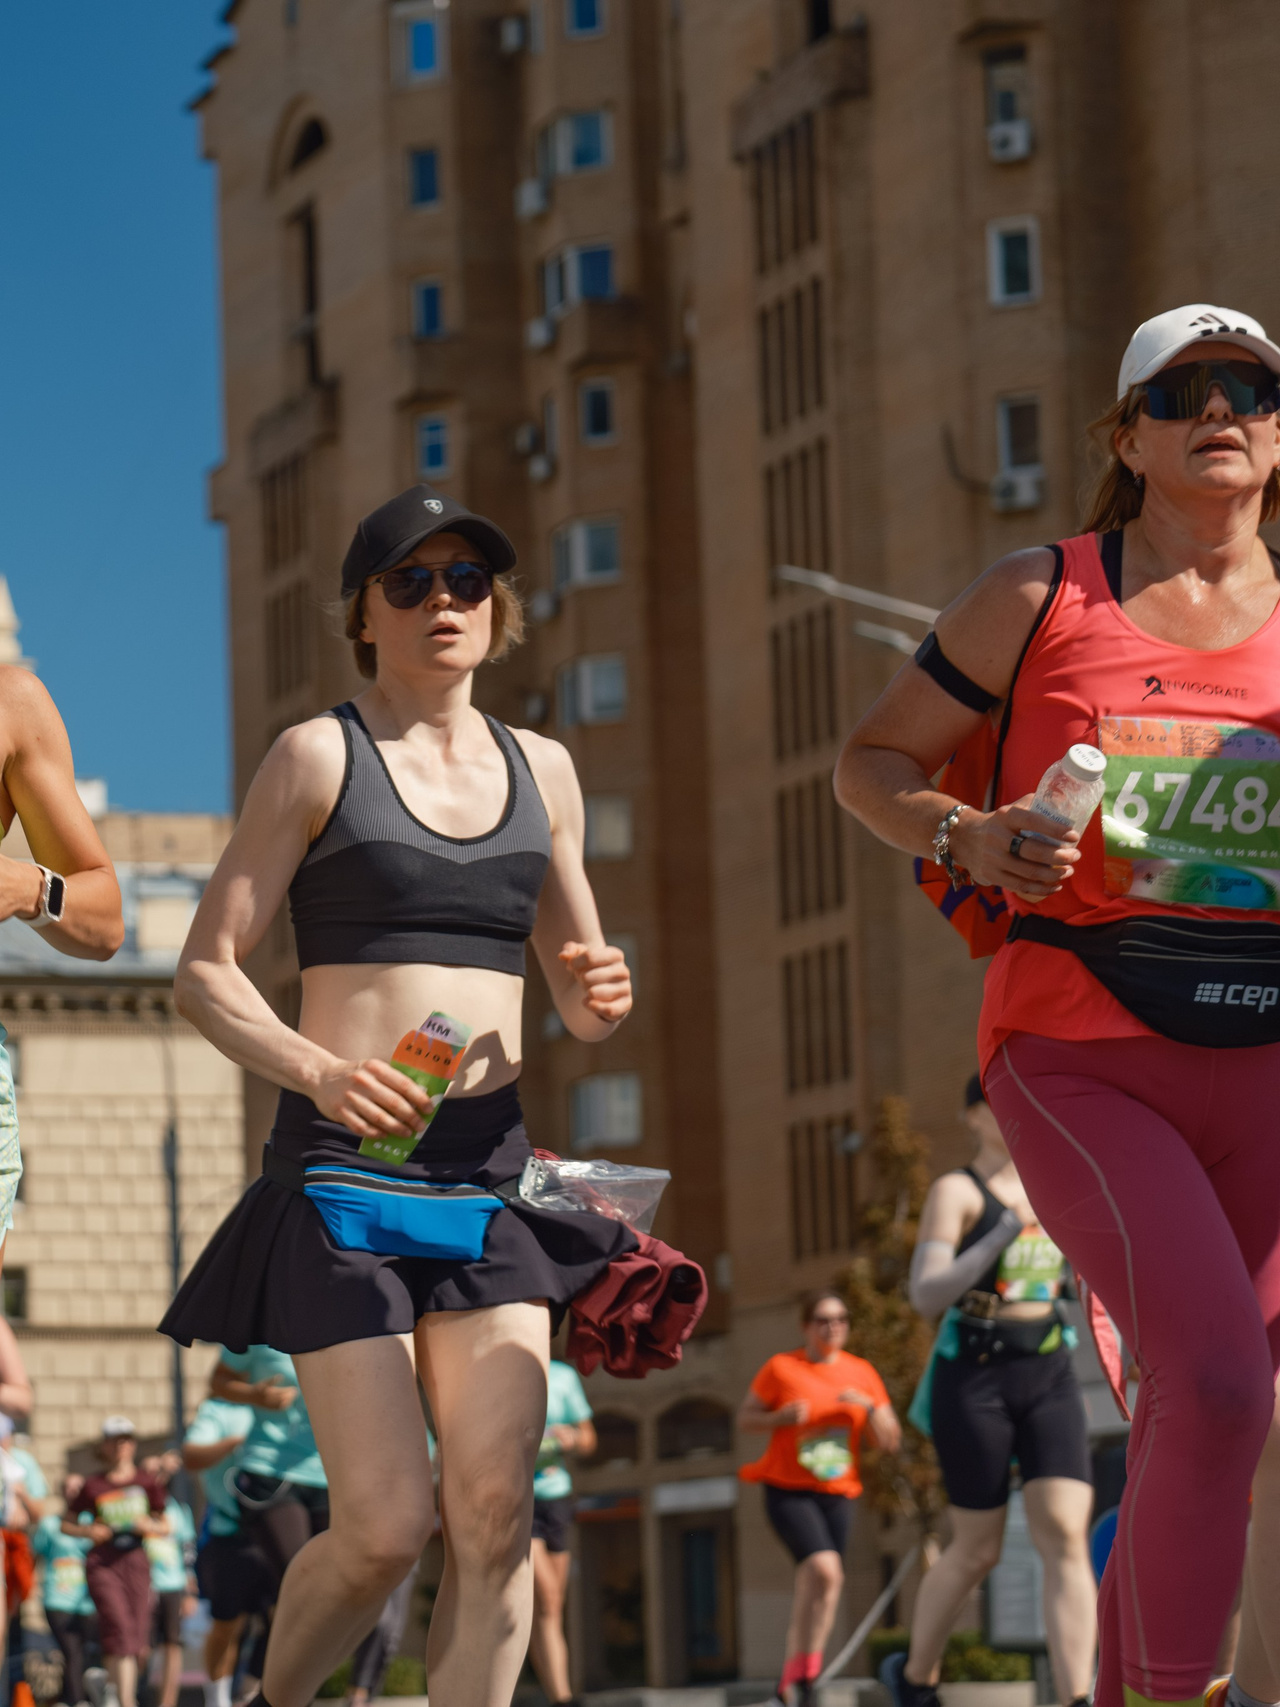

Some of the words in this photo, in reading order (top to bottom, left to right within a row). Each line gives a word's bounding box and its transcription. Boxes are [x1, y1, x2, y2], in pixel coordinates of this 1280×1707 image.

[1162, 679, 1249, 700] INVIGORATE
[1224, 984, 1279, 1013] cep
[406, 1043, 451, 1066] 23/08
